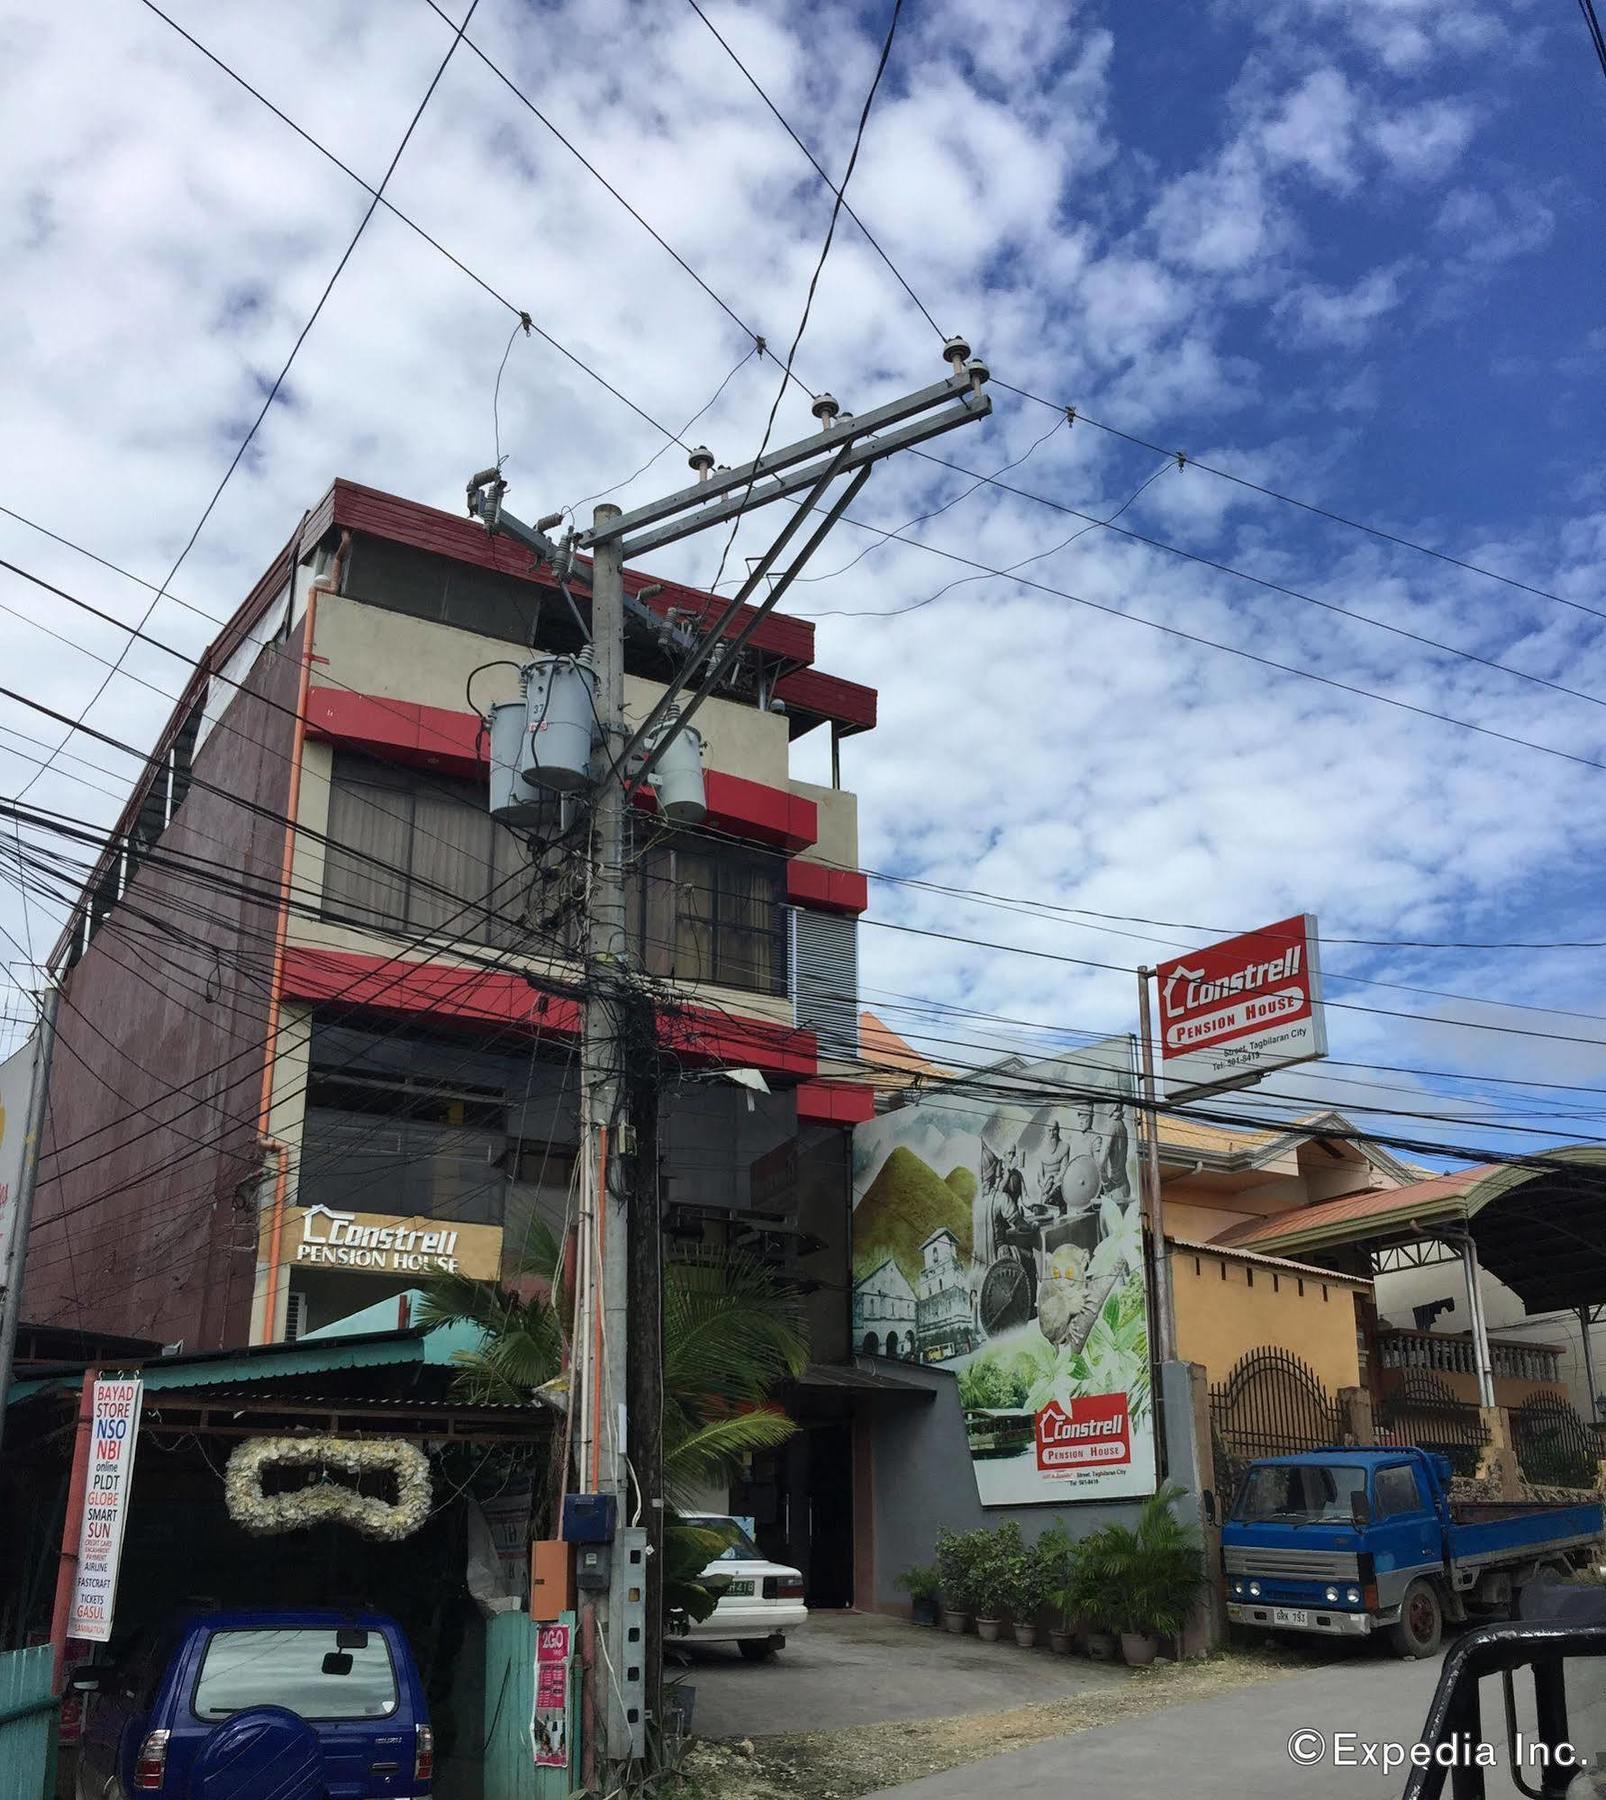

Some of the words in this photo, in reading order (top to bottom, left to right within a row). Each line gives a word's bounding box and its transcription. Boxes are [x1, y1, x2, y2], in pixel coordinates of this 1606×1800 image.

[1186, 945, 1302, 1009] Constrell
[1176, 1014, 1235, 1042] PENSION
[1245, 995, 1295, 1020] HOUSE
[1249, 1033, 1289, 1049] Tagbilaran
[1291, 1028, 1307, 1038] City
[328, 1219, 458, 1256] Constrell
[296, 1244, 386, 1268] PENSION
[97, 1386, 134, 1401] BAYAD
[96, 1402, 130, 1418] STORE
[96, 1418, 127, 1439] NSO
[1054, 1414, 1122, 1440] Constrell
[96, 1440, 121, 1460] NBI
[1048, 1449, 1084, 1461] PENSION
[1090, 1446, 1119, 1457] HOUSE
[95, 1462, 118, 1473] online
[93, 1474, 120, 1490] PLDT
[88, 1491, 119, 1506] GLOBE
[87, 1508, 118, 1522] SMART
[87, 1522, 111, 1538] SUN
[83, 1562, 108, 1573] AIRLINE
[77, 1577, 111, 1589] FASTCRAFT
[80, 1594, 104, 1605] TICKETS
[77, 1605, 104, 1620] GASUL
[542, 1630, 563, 1649] 2GO
